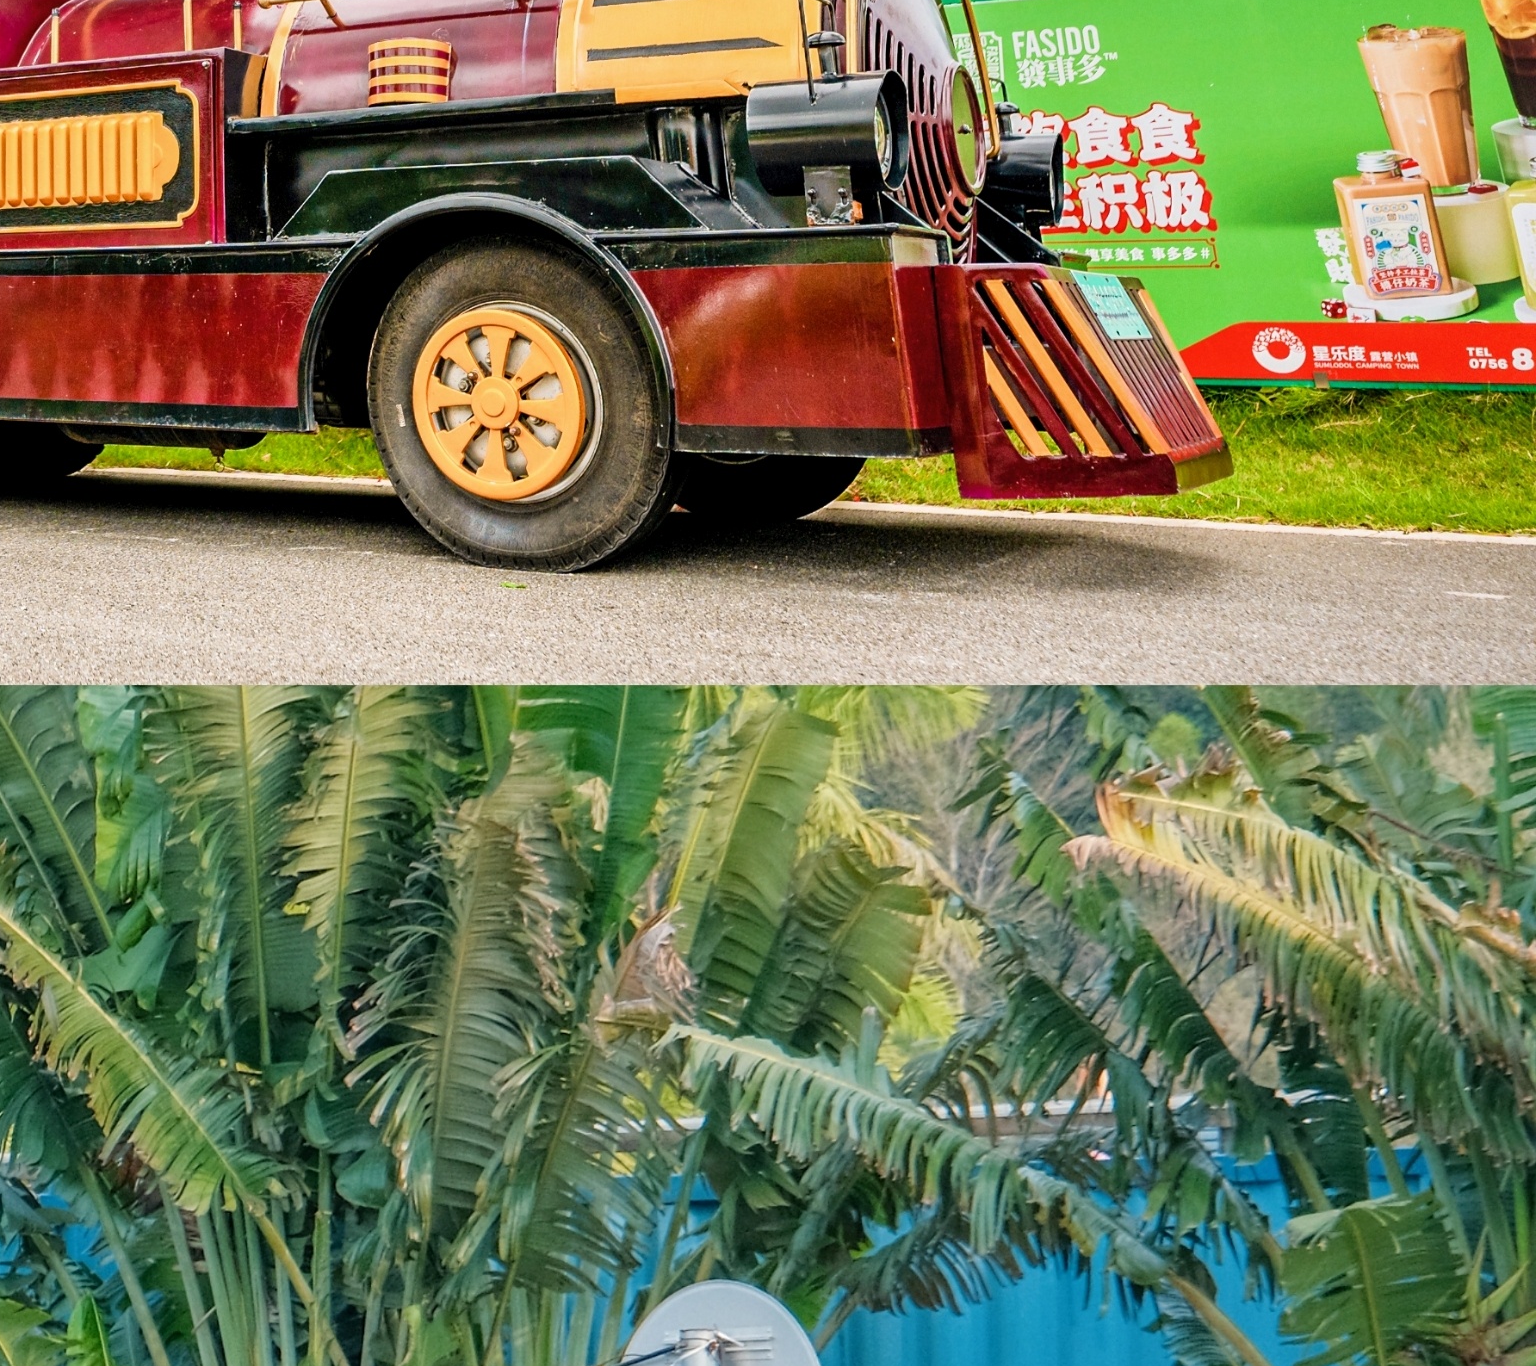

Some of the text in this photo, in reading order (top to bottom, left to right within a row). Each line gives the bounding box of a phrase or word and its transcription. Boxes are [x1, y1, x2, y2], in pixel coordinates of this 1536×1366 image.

[1011, 24, 1101, 60] FASIDO
[1016, 54, 1106, 89] 發事多
[1312, 345, 1366, 362] 星乐度
[1466, 347, 1492, 358] TEL
[1355, 362, 1393, 370] CAMPING
[1469, 358, 1509, 370] 0756
